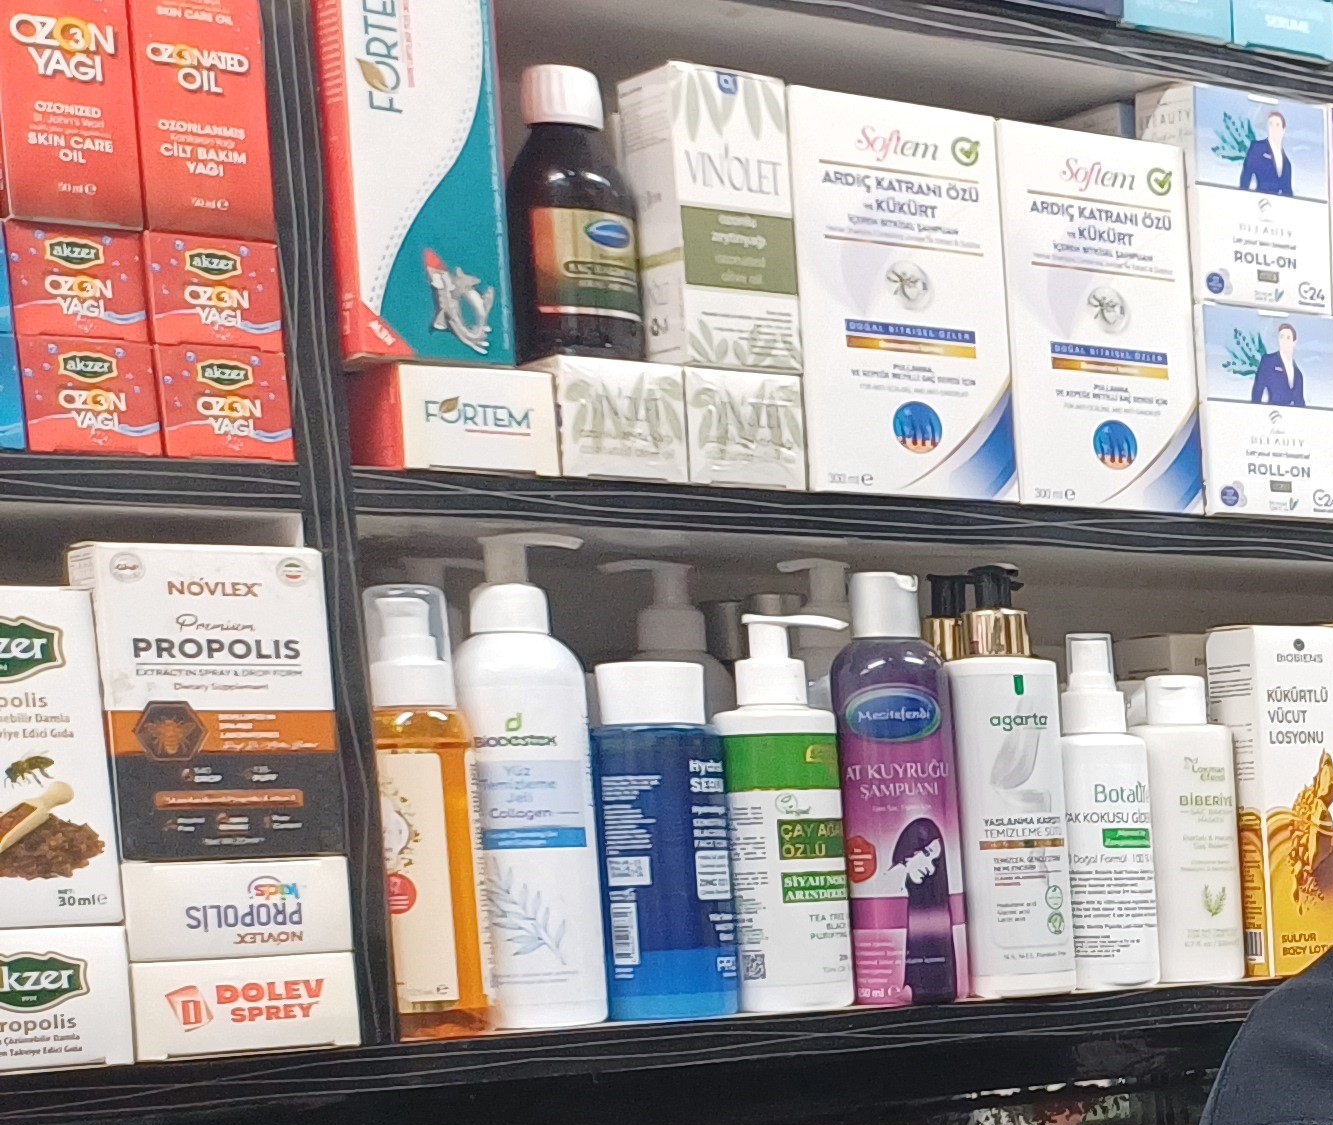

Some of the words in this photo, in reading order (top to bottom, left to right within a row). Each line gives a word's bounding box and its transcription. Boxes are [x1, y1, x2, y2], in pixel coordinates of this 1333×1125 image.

[177, 67, 224, 94] OIL
[27, 131, 66, 147] SKIN
[70, 135, 114, 153] CARE
[58, 149, 87, 165] OIL
[876, 197, 938, 219] KÜKÜRT
[1078, 225, 1135, 247] KÜKÜRT
[53, 243, 97, 260] akzer
[1234, 251, 1297, 270] ROLL-ON
[192, 254, 236, 271] akzer
[1308, 289, 1325, 301] 24
[65, 358, 111, 374] akzer
[204, 365, 246, 382] akzer
[424, 398, 532, 432] FORTEM
[1247, 462, 1311, 479] ROLL-ON
[132, 637, 302, 660] PROPOLIS
[1267, 686, 1329, 703] KÜKÜRTLÜ
[35, 713, 71, 723] Damla
[990, 713, 1048, 732] agarta
[1267, 706, 1308, 724] VÜCUT
[1269, 731, 1325, 744] LOSYONU
[844, 765, 863, 780] AT
[867, 758, 950, 780] KUYRUĞU
[860, 782, 940, 800] ŞAMPUANI
[488, 807, 551, 820] Collagen
[1083, 811, 1130, 824] KOKUSU
[780, 823, 813, 842] ÇAY
[781, 840, 826, 858] ÖZLÜ
[783, 874, 823, 888] SİYAH
[58, 894, 76, 907] 30
[215, 978, 327, 1005] DOLEV
[231, 1001, 321, 1024] SPREY
